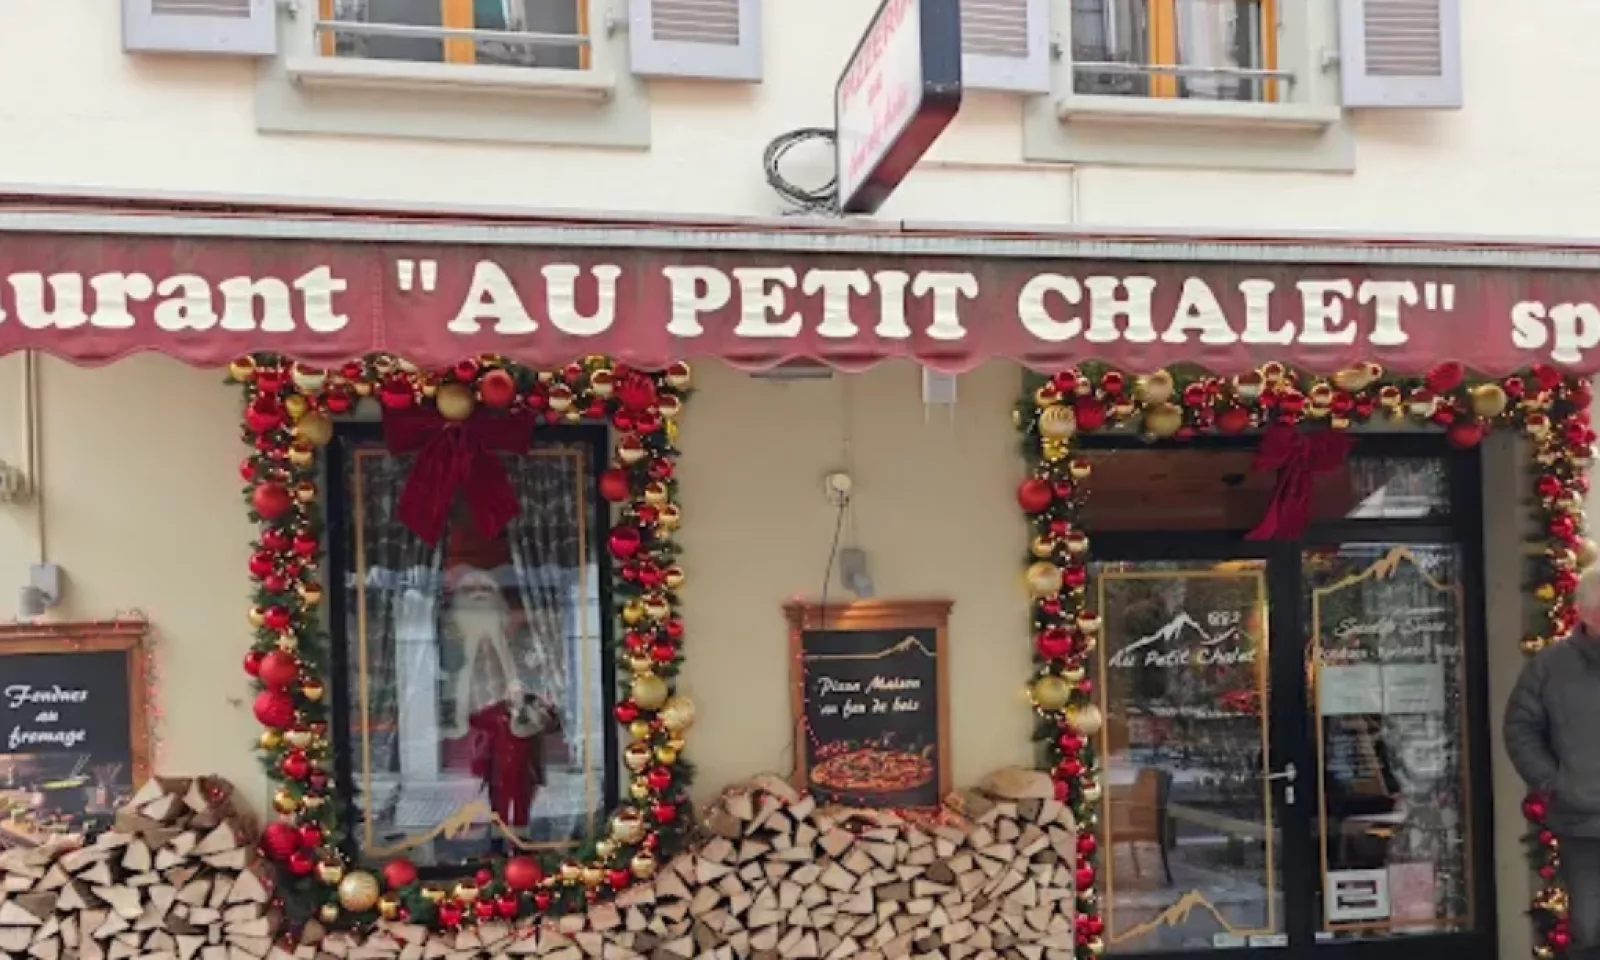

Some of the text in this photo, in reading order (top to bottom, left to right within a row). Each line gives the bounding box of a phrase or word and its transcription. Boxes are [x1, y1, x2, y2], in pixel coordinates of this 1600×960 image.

[0, 270, 350, 334] urant
[395, 258, 623, 337] "AU
[660, 264, 980, 342] PETIT
[1017, 272, 1457, 346] CHALET"
[8, 725, 87, 750] fromage
